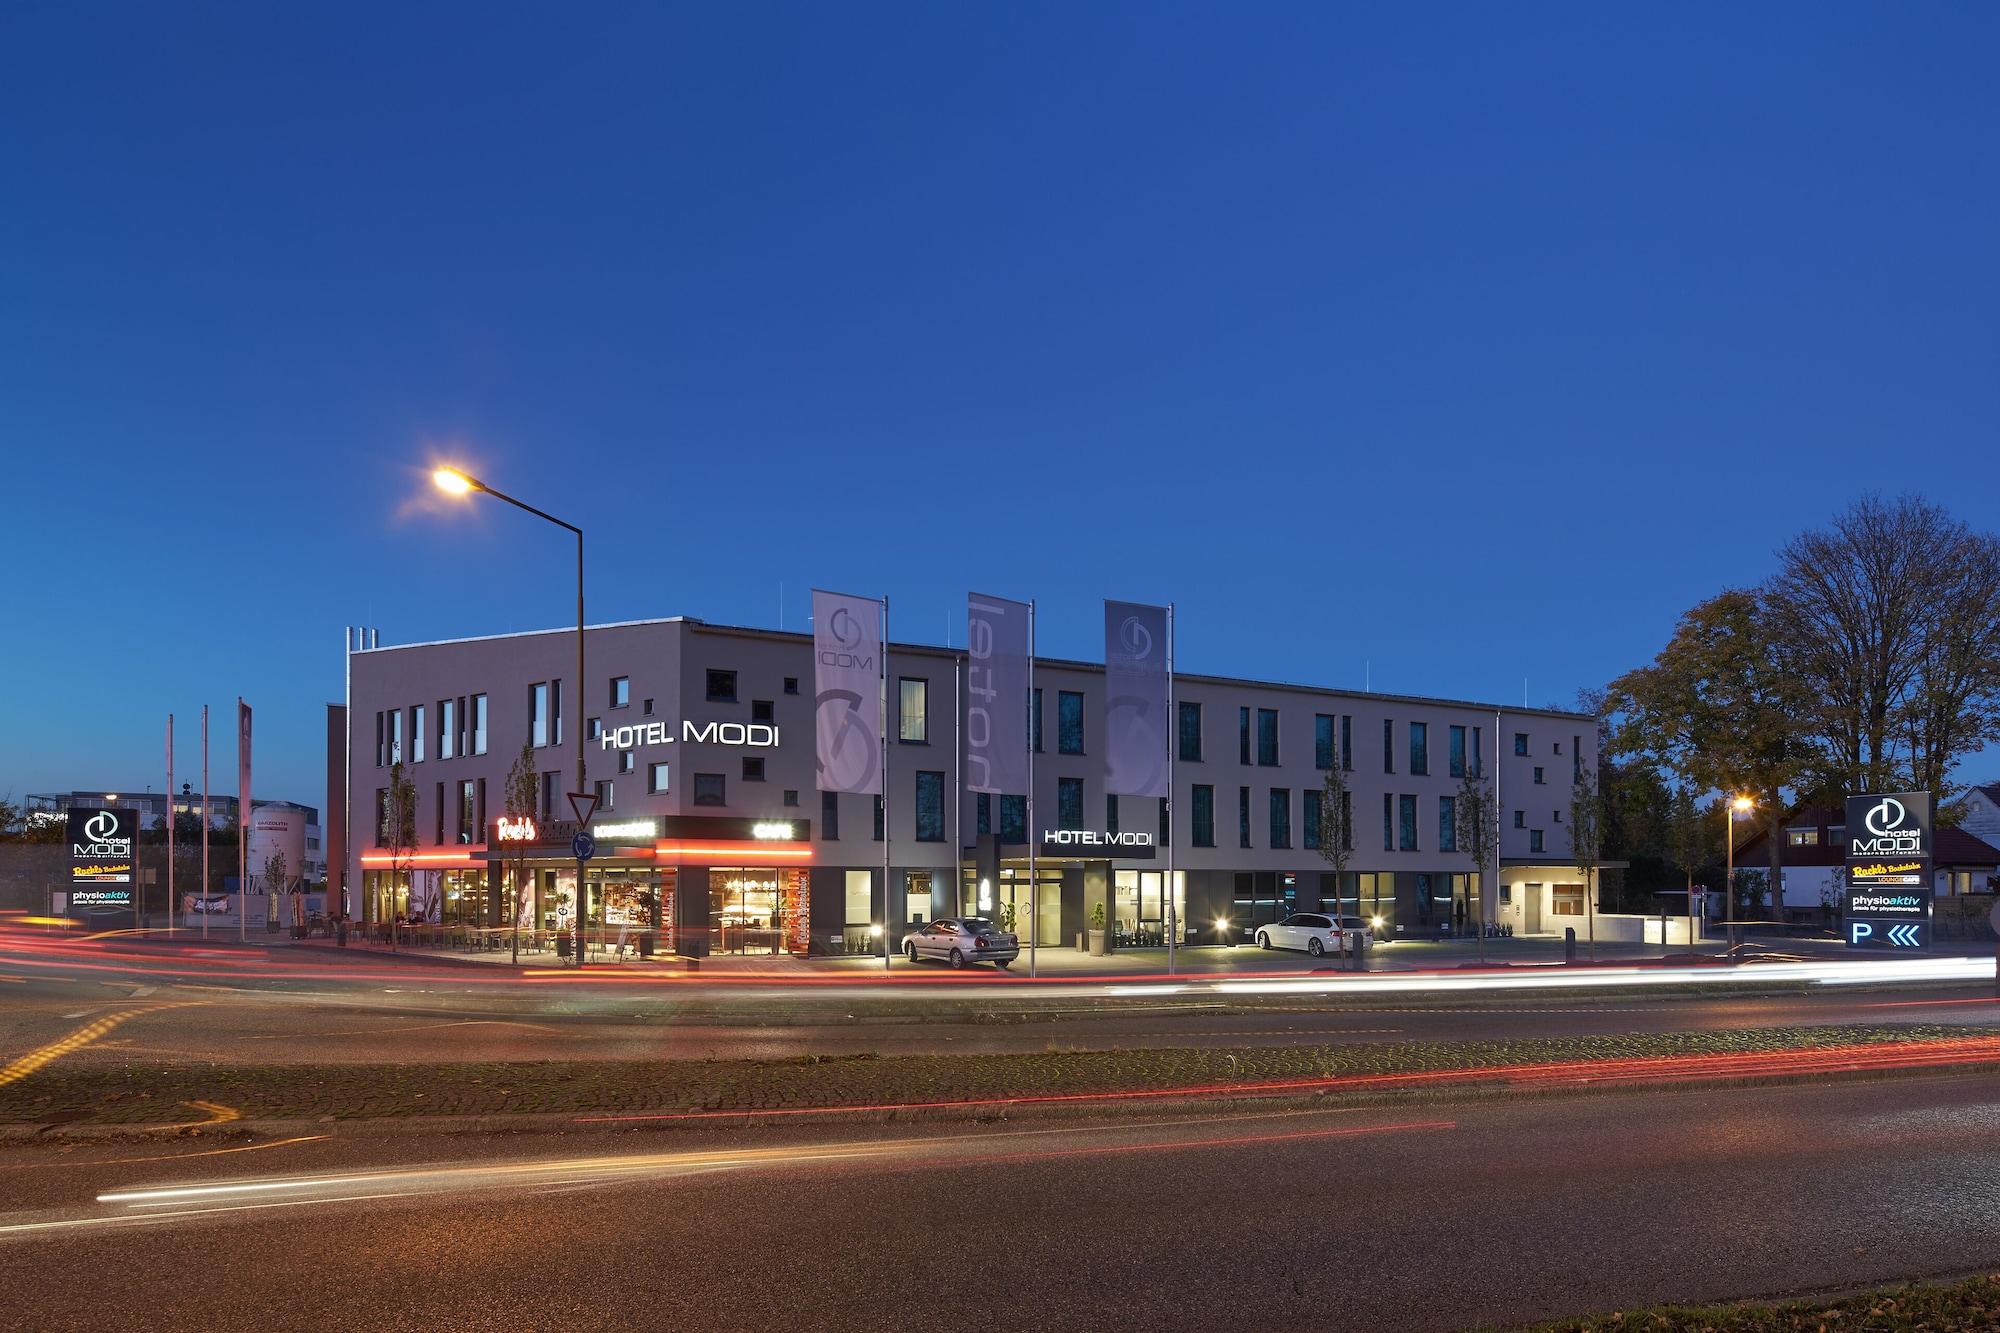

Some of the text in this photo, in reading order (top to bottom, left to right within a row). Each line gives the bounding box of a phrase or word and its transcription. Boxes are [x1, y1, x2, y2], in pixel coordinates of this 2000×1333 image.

[602, 720, 779, 750] HOTEL MODI
[1044, 829, 1152, 846] HOTEL MODI
[1884, 828, 1920, 837] hotel
[73, 844, 130, 855] MODI
[1853, 837, 1920, 852] MODI
[1853, 864, 1887, 876] Rackls
[73, 891, 130, 900] physioaktiv
[1853, 896, 1920, 906] physioaktiv
[1852, 923, 1873, 944] P
